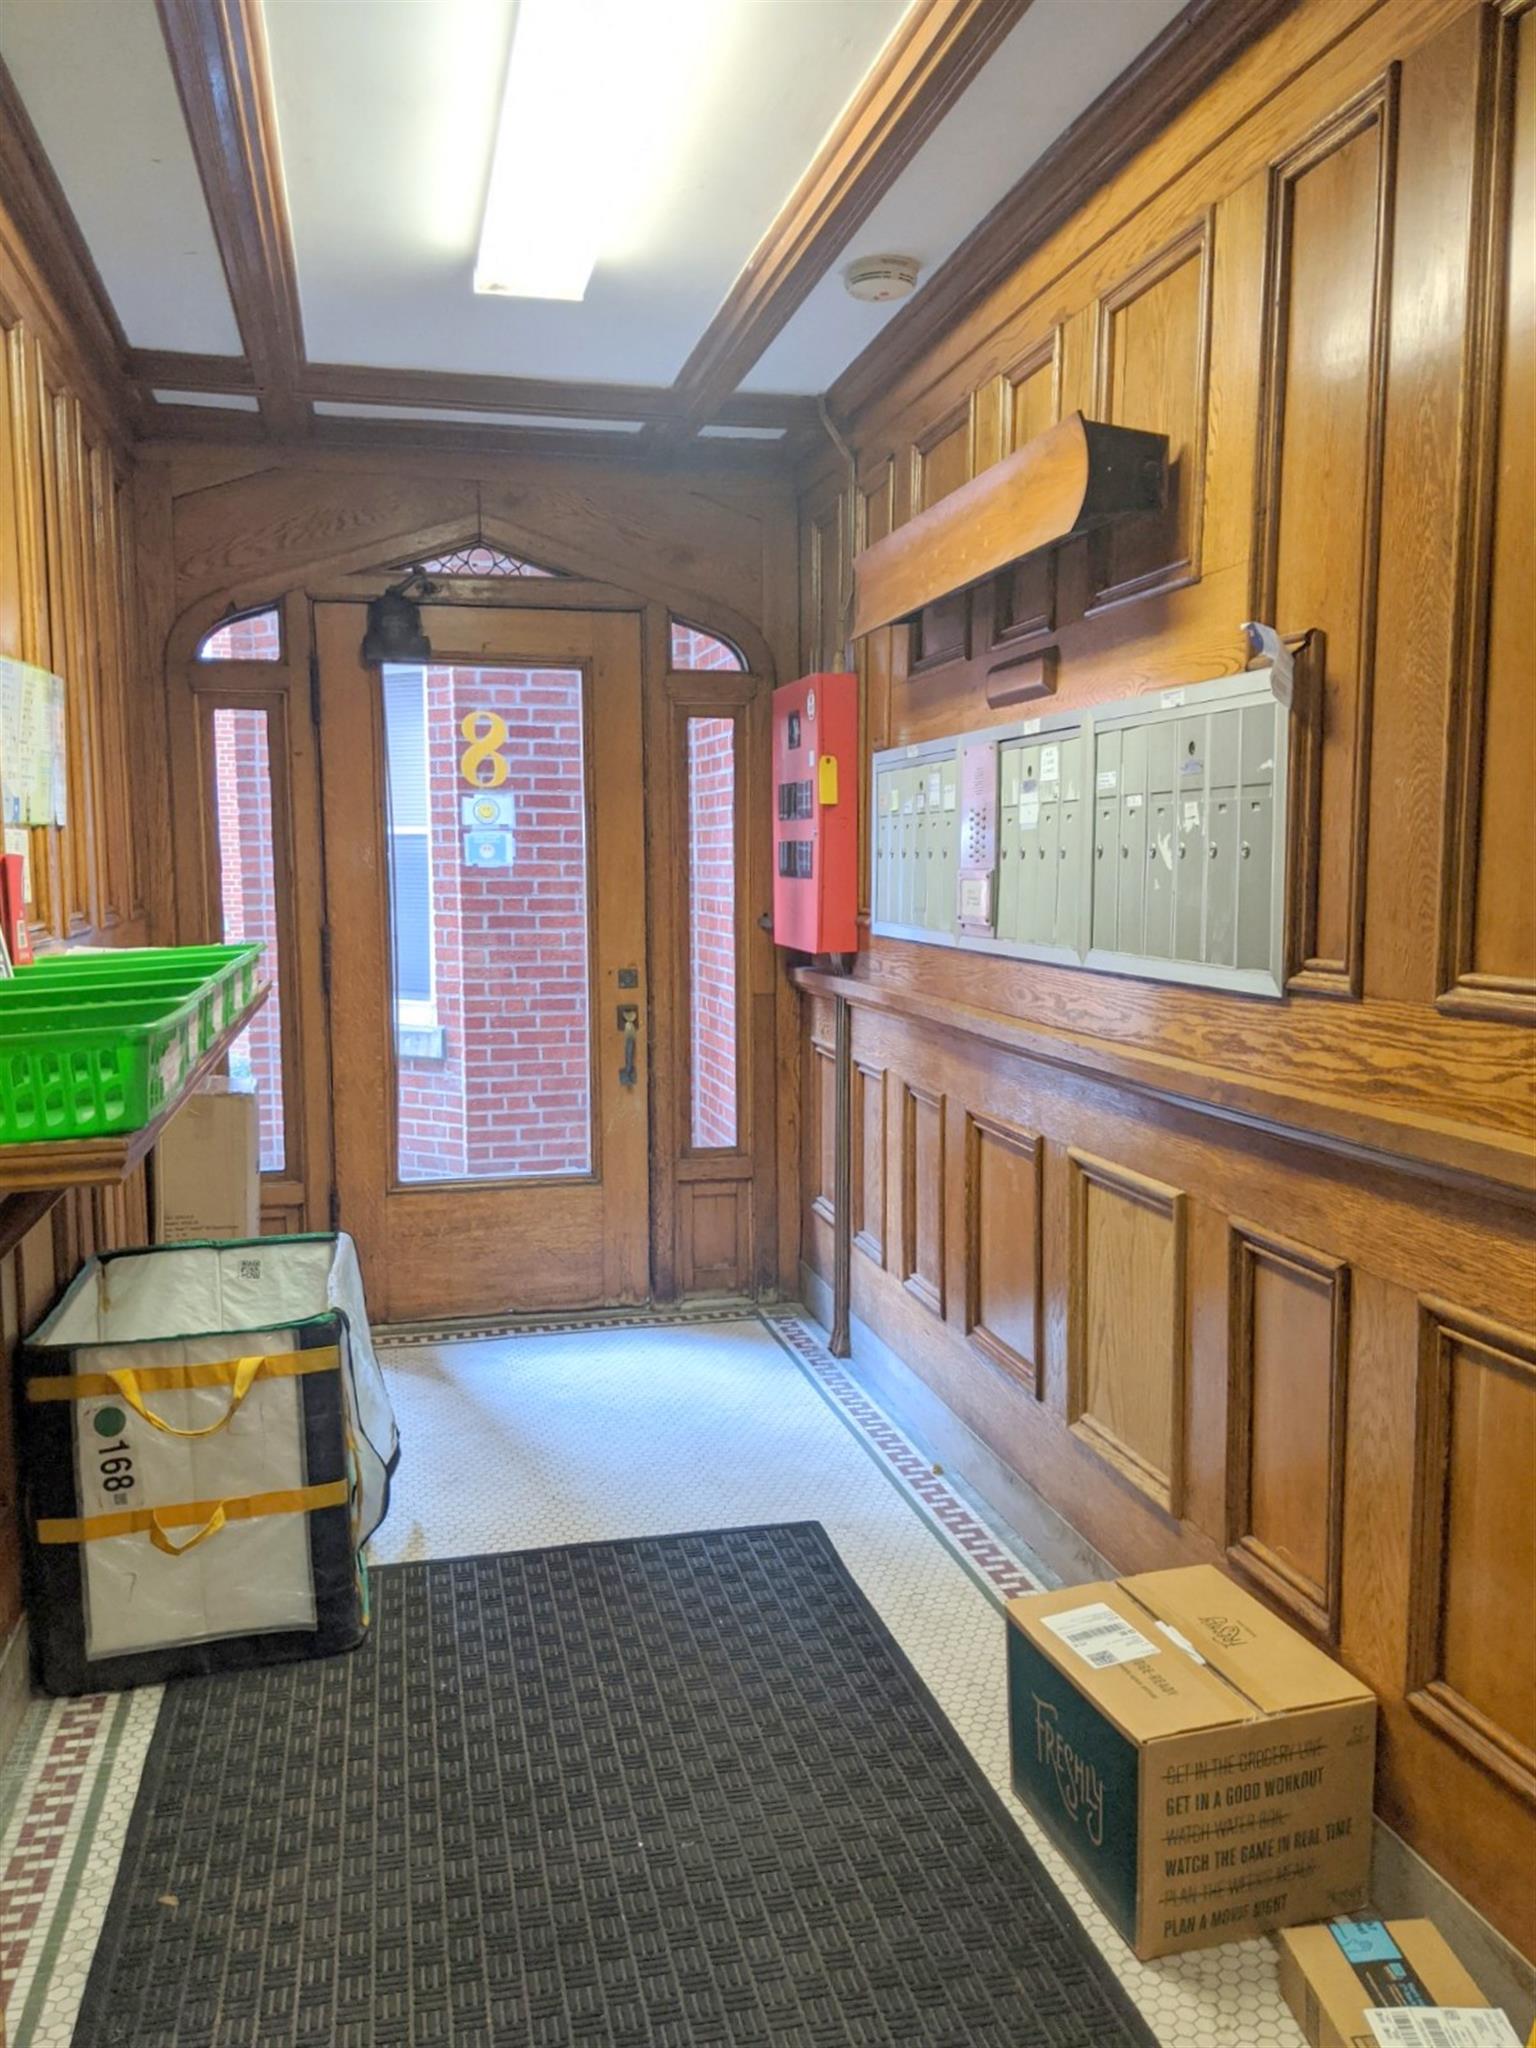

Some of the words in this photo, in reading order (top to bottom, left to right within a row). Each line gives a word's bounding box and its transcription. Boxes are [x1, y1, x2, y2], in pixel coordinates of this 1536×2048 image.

[460, 710, 509, 788] 8
[98, 1439, 135, 1492] 168
[1166, 1795, 1191, 1816] GET
[1195, 1793, 1210, 1811] IN
[1213, 1791, 1222, 1809] A
[1226, 1782, 1261, 1807] GOOD
[1264, 1766, 1325, 1797] WORKOUT
[1165, 1854, 1209, 1878] WATCH
[1214, 1849, 1237, 1870] THE
[1241, 1838, 1275, 1863] GAME
[1278, 1834, 1290, 1852] IN
[1294, 1827, 1321, 1849] REAL
[1325, 1817, 1353, 1842] TIME
[1164, 1916, 1195, 1938] PLAN
[1199, 1911, 1208, 1930] A
[1253, 1893, 1289, 1917] NIGHT
